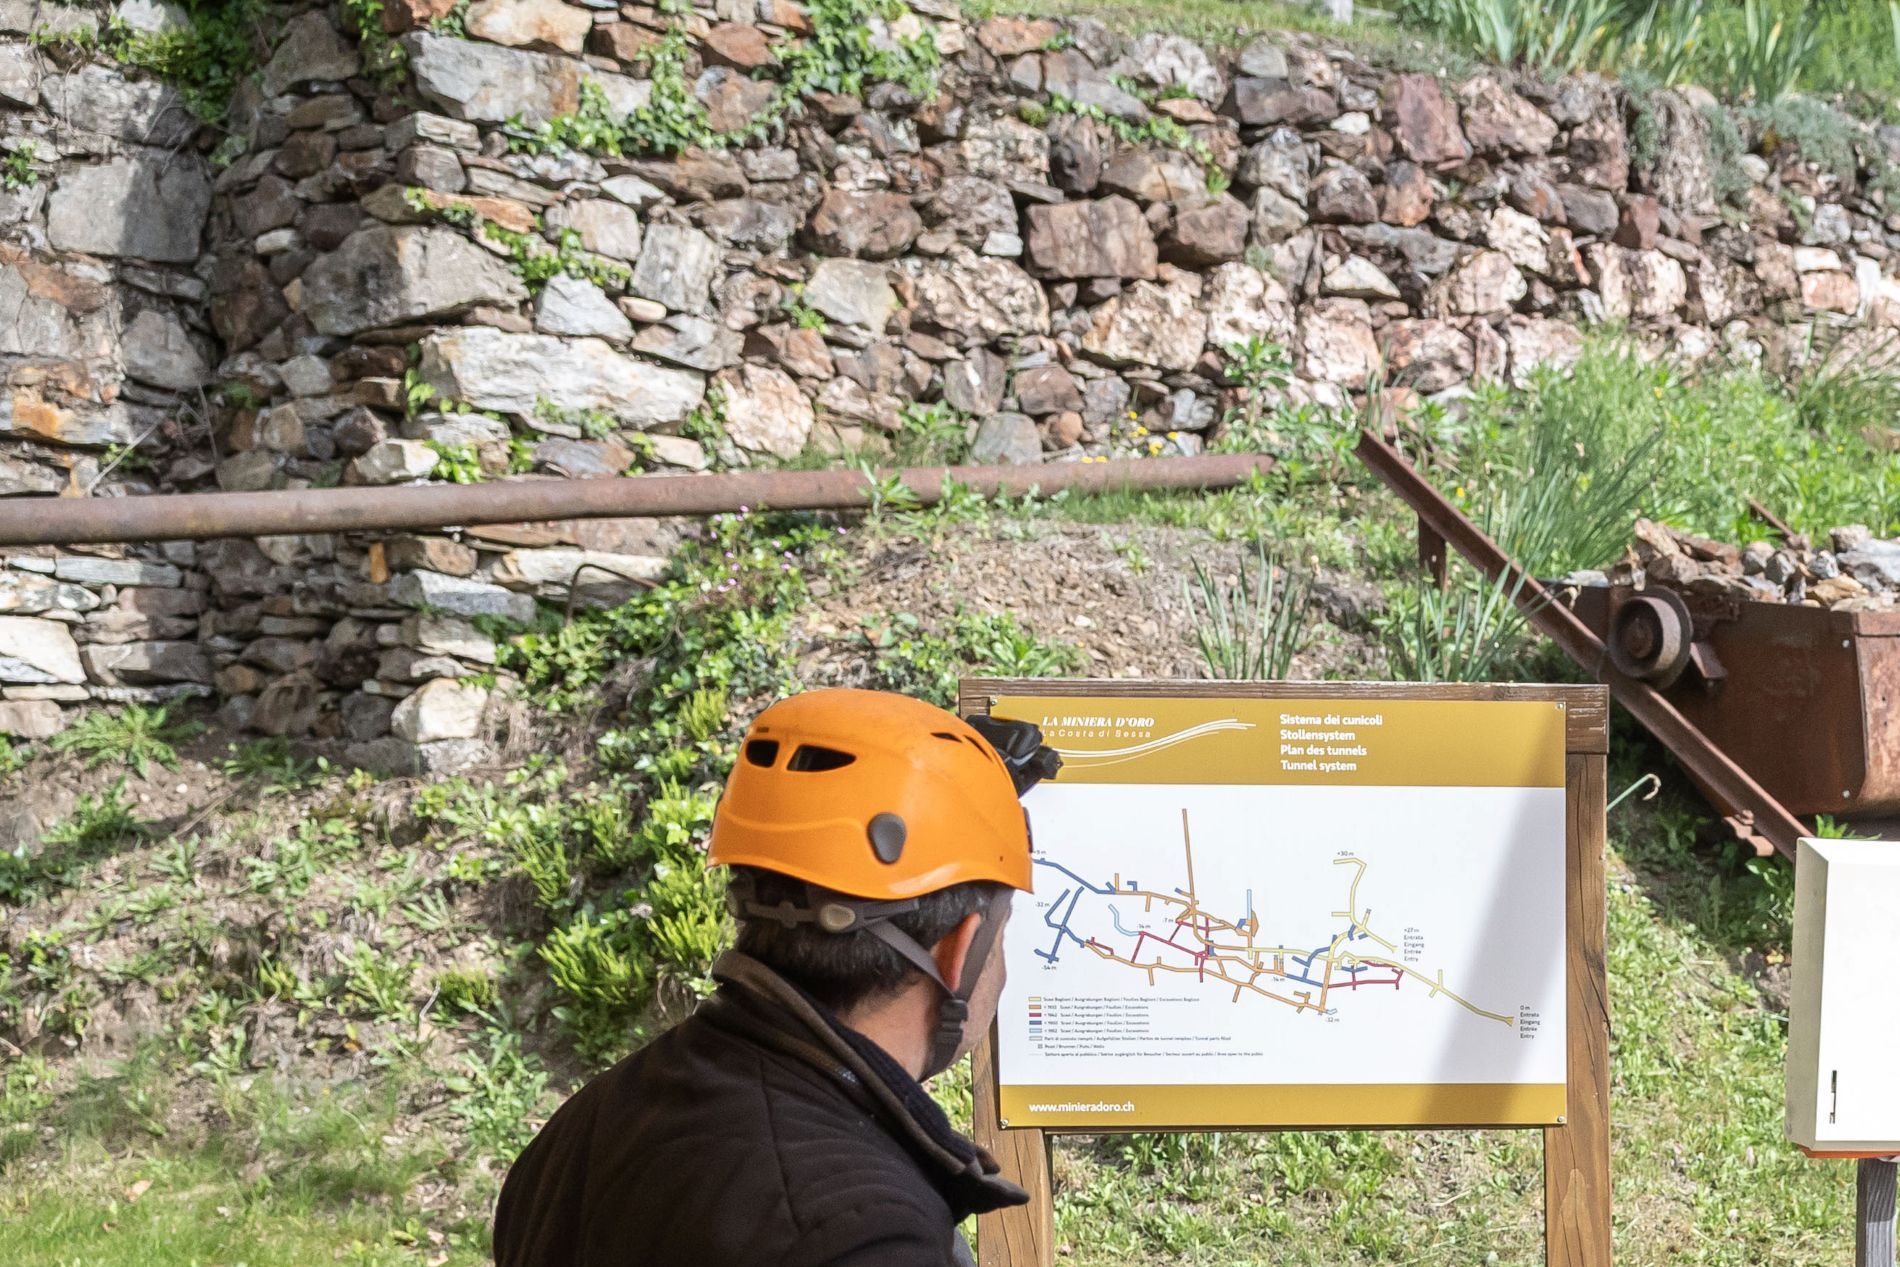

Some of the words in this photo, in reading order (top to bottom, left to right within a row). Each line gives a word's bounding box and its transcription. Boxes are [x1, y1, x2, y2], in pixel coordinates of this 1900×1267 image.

[1042, 716, 1059, 727] LA
[1061, 716, 1113, 727] MINIERA
[1115, 716, 1155, 728] D'ORO
[1280, 714, 1321, 725] Sistema
[1324, 714, 1340, 725] dei
[1342, 714, 1383, 726] cunicoli
[1280, 729, 1355, 742] Stollensystem
[1281, 745, 1304, 756] Plan
[1306, 745, 1324, 756] des
[1327, 745, 1367, 756] tunnels
[1281, 760, 1317, 771] Tunnel
[1320, 761, 1357, 773] system
[1028, 1101, 1135, 1113] www.minieradoro.ch
